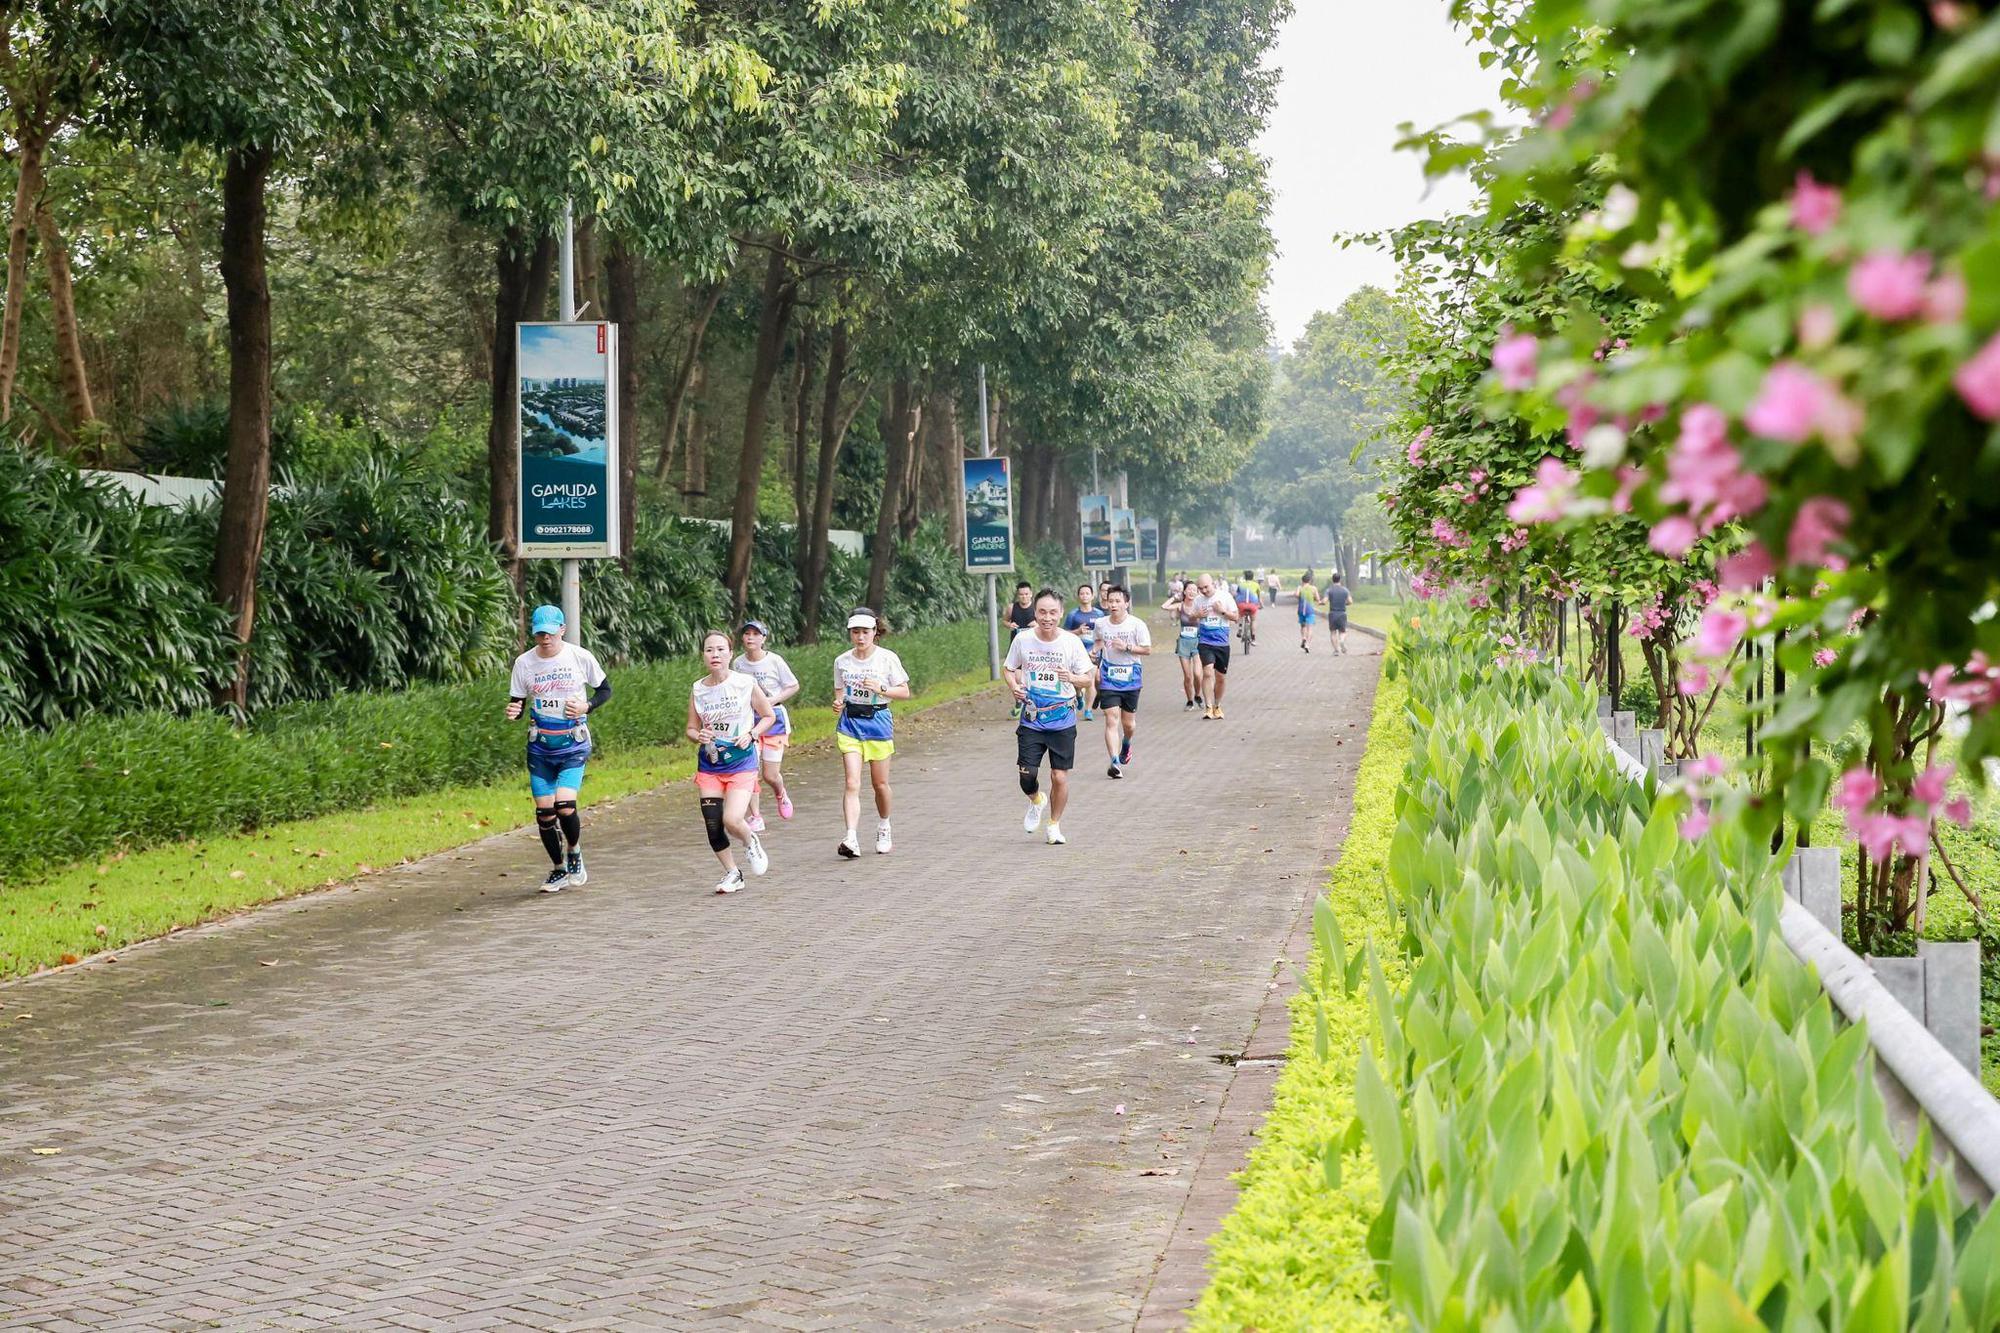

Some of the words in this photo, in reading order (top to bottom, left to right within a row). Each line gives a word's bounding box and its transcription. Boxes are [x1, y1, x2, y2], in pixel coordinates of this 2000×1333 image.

[531, 483, 597, 497] GAMUDA
[541, 497, 587, 509] LAKES
[971, 536, 1005, 544] GAMUDA
[534, 673, 572, 684] MARCOM
[853, 689, 869, 698] 298
[542, 699, 559, 708] 241
[703, 701, 738, 712] MARCOM
[713, 722, 730, 731] 287
